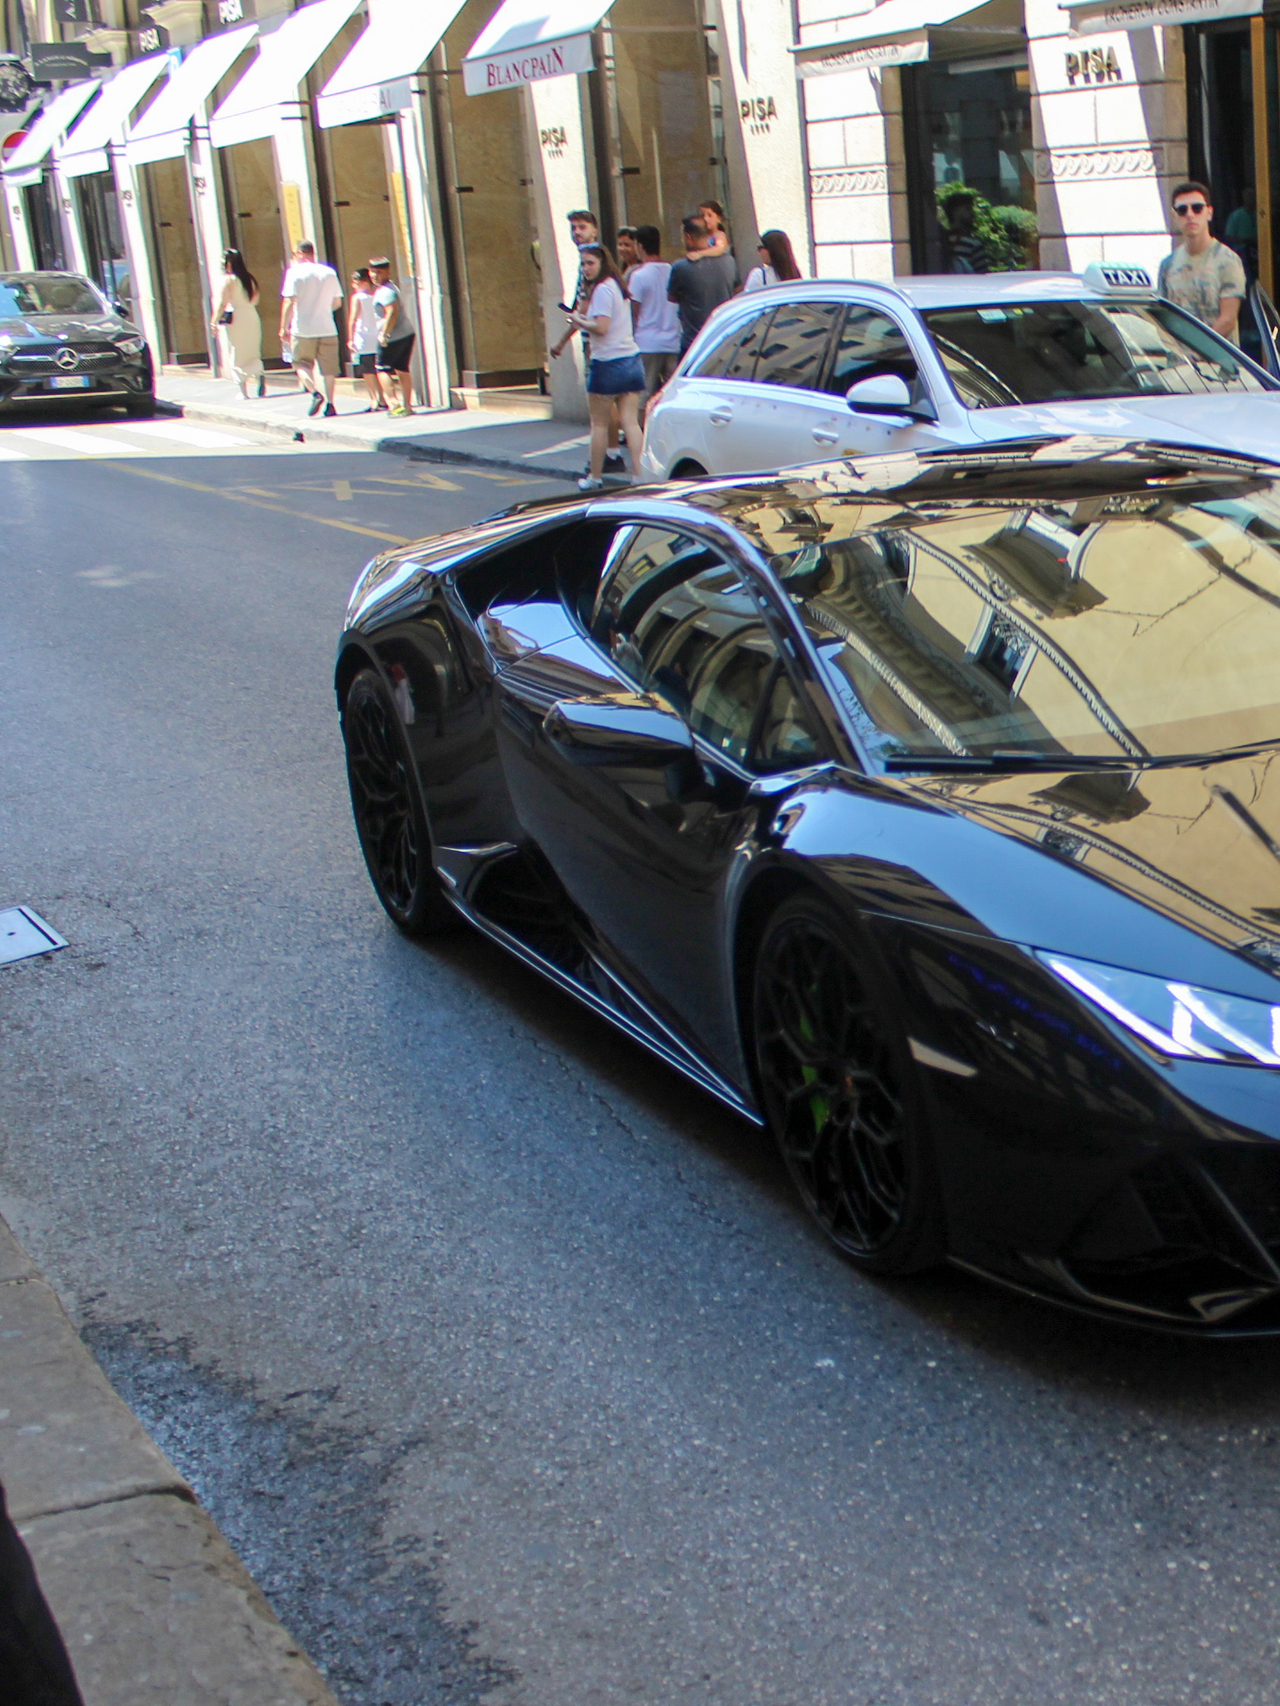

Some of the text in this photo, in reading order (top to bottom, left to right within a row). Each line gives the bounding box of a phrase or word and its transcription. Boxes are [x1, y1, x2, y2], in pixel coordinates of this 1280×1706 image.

[486, 46, 565, 87] BLANCPAIN
[1065, 46, 1122, 83] PISA
[740, 95, 778, 123] PISA
[541, 126, 568, 148] PISA
[1103, 269, 1150, 286] TAXI
